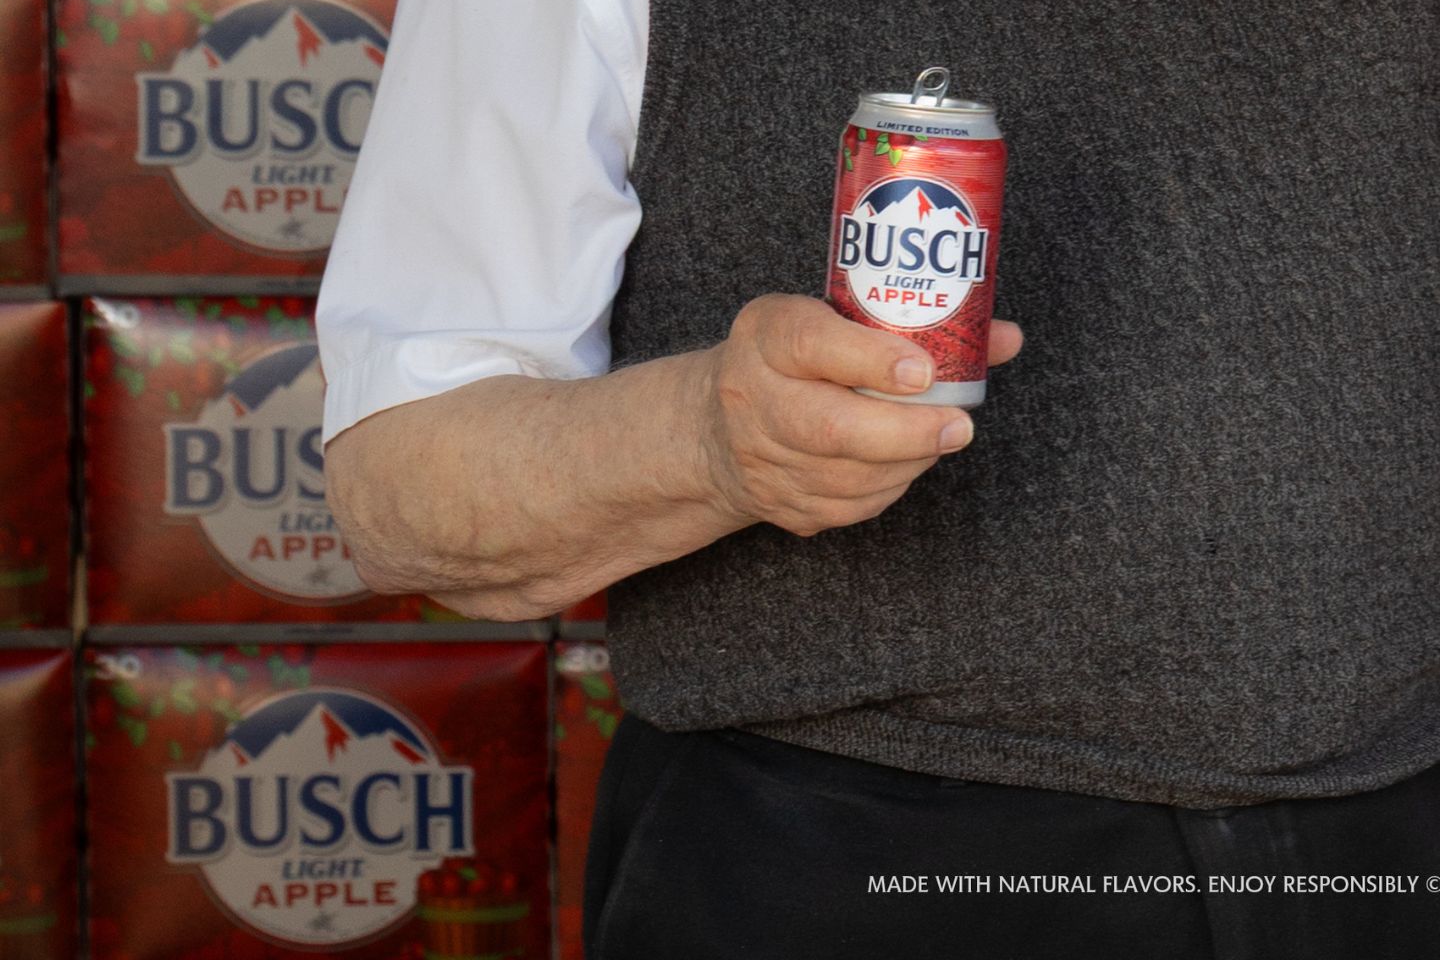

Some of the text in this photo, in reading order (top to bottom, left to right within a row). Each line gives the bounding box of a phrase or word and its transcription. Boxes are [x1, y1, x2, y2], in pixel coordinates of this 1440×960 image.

[143, 79, 376, 159] BUSC
[876, 120, 969, 137] LIMITED EDITION
[251, 165, 336, 185] LIGHT
[222, 188, 346, 213] APPL
[839, 217, 988, 279] BUSCH
[883, 274, 937, 290] LIGHT
[866, 286, 949, 309] APPLE
[172, 427, 325, 509] BUS
[98, 654, 142, 681] 30
[562, 646, 610, 673] 30
[174, 772, 470, 857] BUSCH
[282, 859, 365, 879] LIGHT
[252, 881, 397, 908] APPLE
